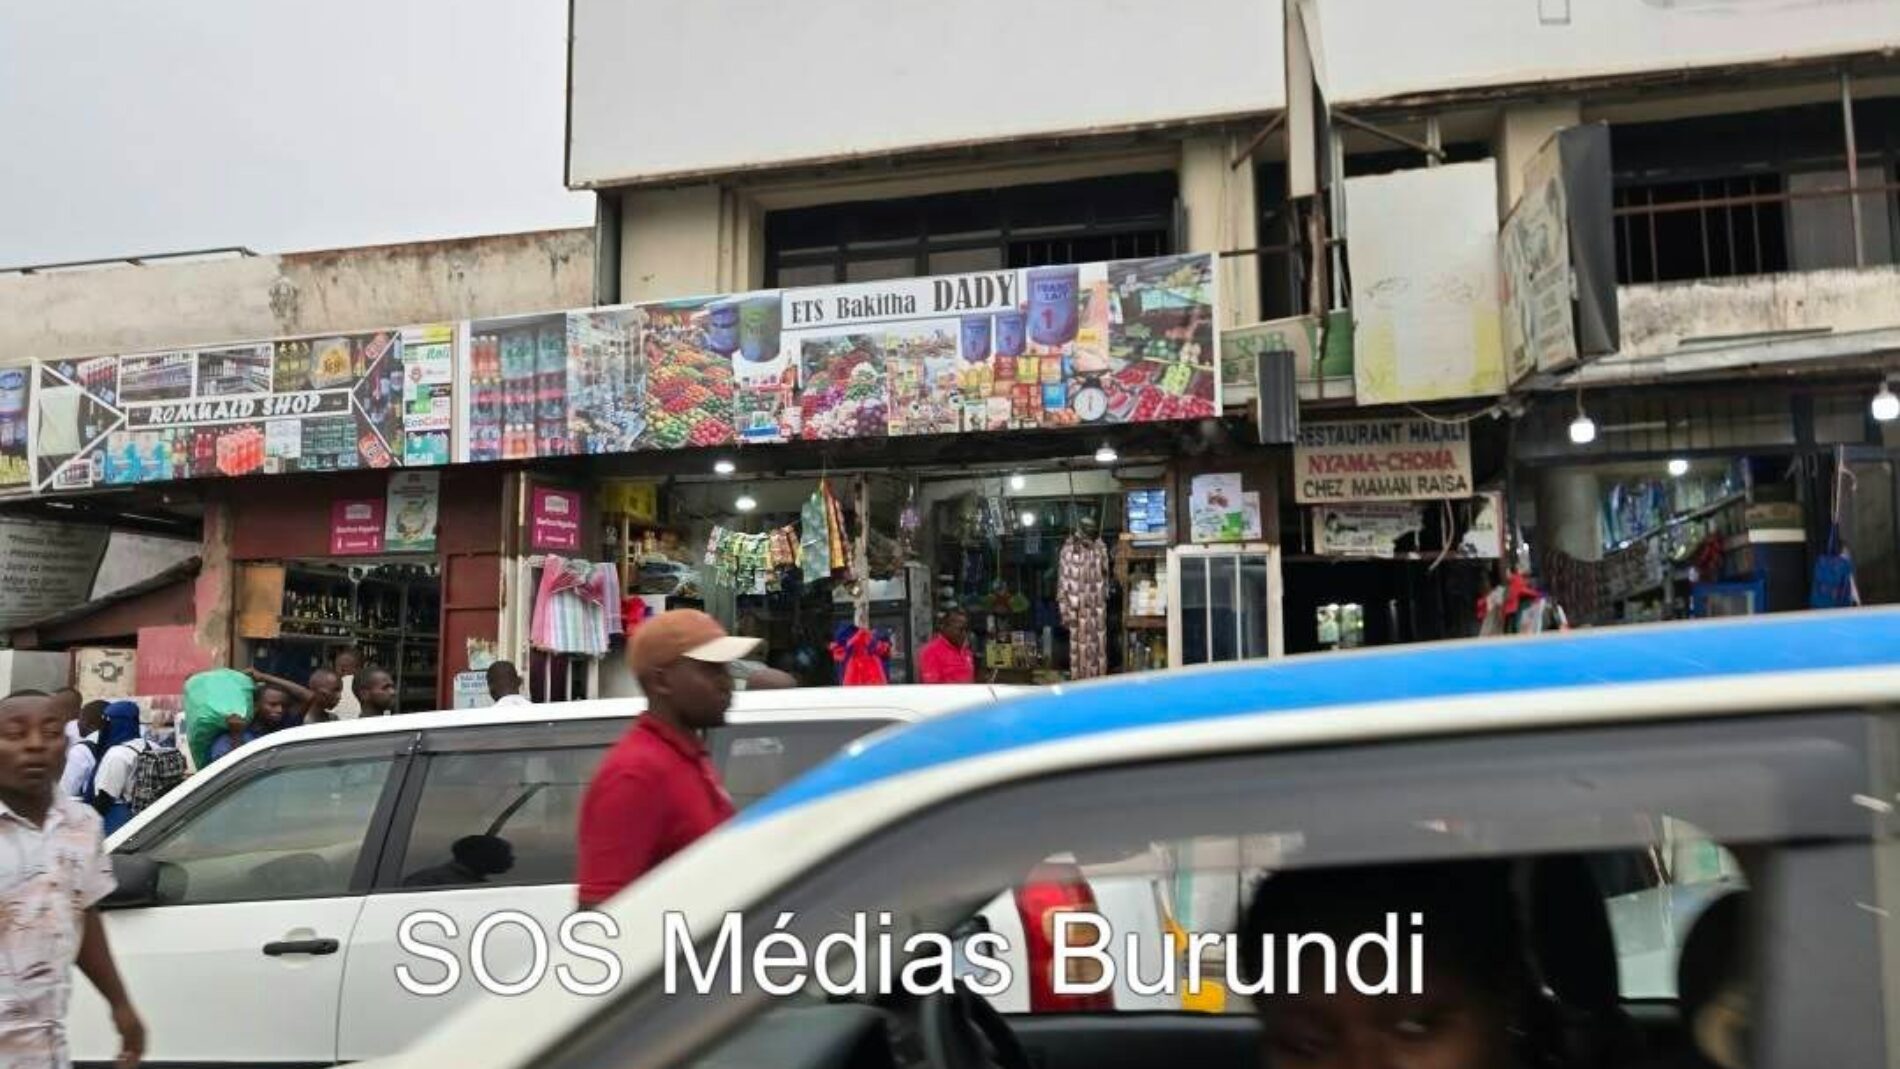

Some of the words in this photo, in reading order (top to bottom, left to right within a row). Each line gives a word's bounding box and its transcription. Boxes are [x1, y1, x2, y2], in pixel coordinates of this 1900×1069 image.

[792, 301, 824, 323] ETS
[837, 293, 916, 319] Bakitha
[934, 274, 1014, 312] DADY
[262, 393, 322, 416] SHOP
[1308, 450, 1458, 475] NYAMA-CHOMA
[1303, 478, 1345, 498] CHEZ
[1351, 475, 1412, 496] MAMAN
[1417, 473, 1468, 493] RAISA
